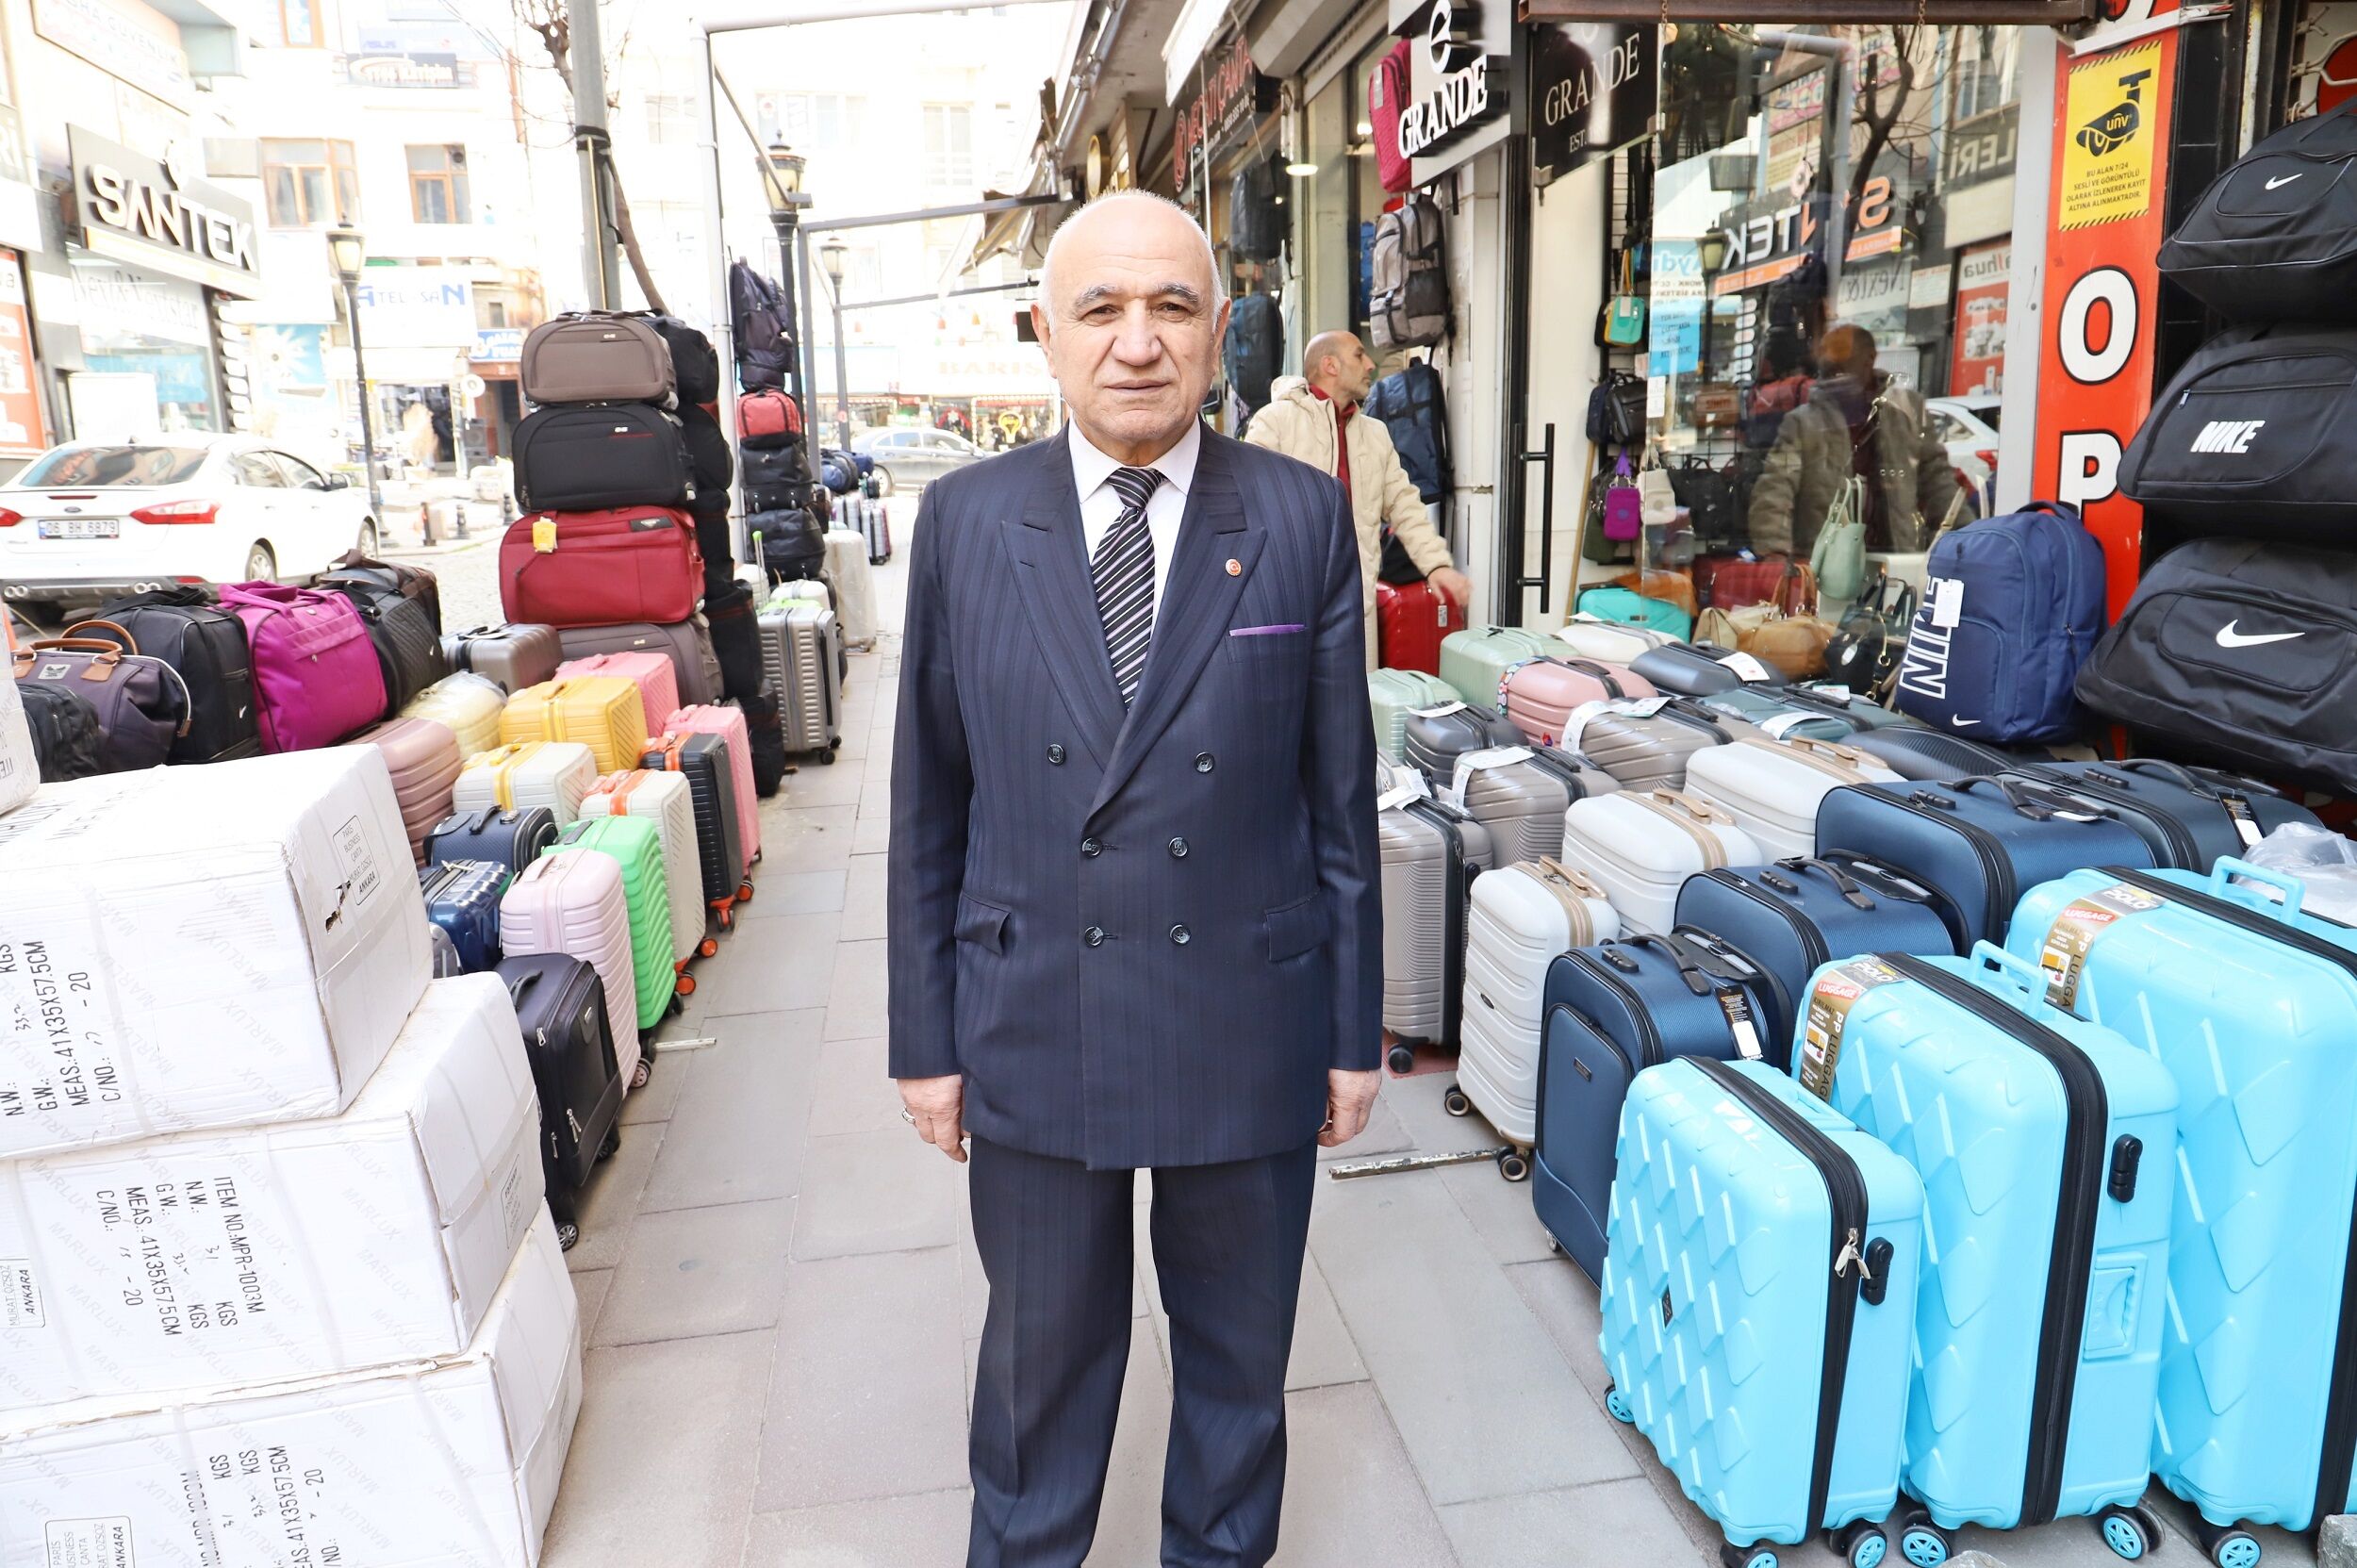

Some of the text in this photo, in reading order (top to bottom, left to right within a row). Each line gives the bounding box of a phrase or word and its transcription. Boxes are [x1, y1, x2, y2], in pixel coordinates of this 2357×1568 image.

[1545, 32, 1640, 125] GRANDE
[1398, 55, 1488, 158] GRANDE
[2097, 165, 2114, 175] ALAN
[2067, 191, 2092, 202] OLARAK
[2127, 178, 2146, 189] KAYIT
[2069, 202, 2090, 211] ALTINA
[91, 163, 258, 272] SANTEK
[2190, 420, 2266, 454] NIKE
[46, 522, 60, 534] 06
[2064, 909, 2114, 922] LUGGAGE
[67, 970, 91, 994] 20
[1818, 982, 1859, 999] LUGGAGE
[2061, 954, 2082, 1007] LUGGA
[94, 1055, 122, 1103] C/NO.:
[1820, 1033, 1839, 1098] LUGGAG
[32, 1077, 58, 1112] G.W.:
[213, 1176, 237, 1210] ITEM
[96, 1189, 122, 1233] C/NO.:
[123, 1288, 144, 1308] 20
[155, 1182, 179, 1217] G.W.:
[187, 1302, 210, 1330] KGS
[184, 1180, 209, 1214] N.W.:
[214, 1300, 239, 1329] KGS
[19, 1269, 37, 1316] ANKARA
[209, 1454, 232, 1480] KGS
[239, 1449, 261, 1476] KGS
[304, 1468, 324, 1486] 20
[79, 1537, 91, 1566] ÇANTA
